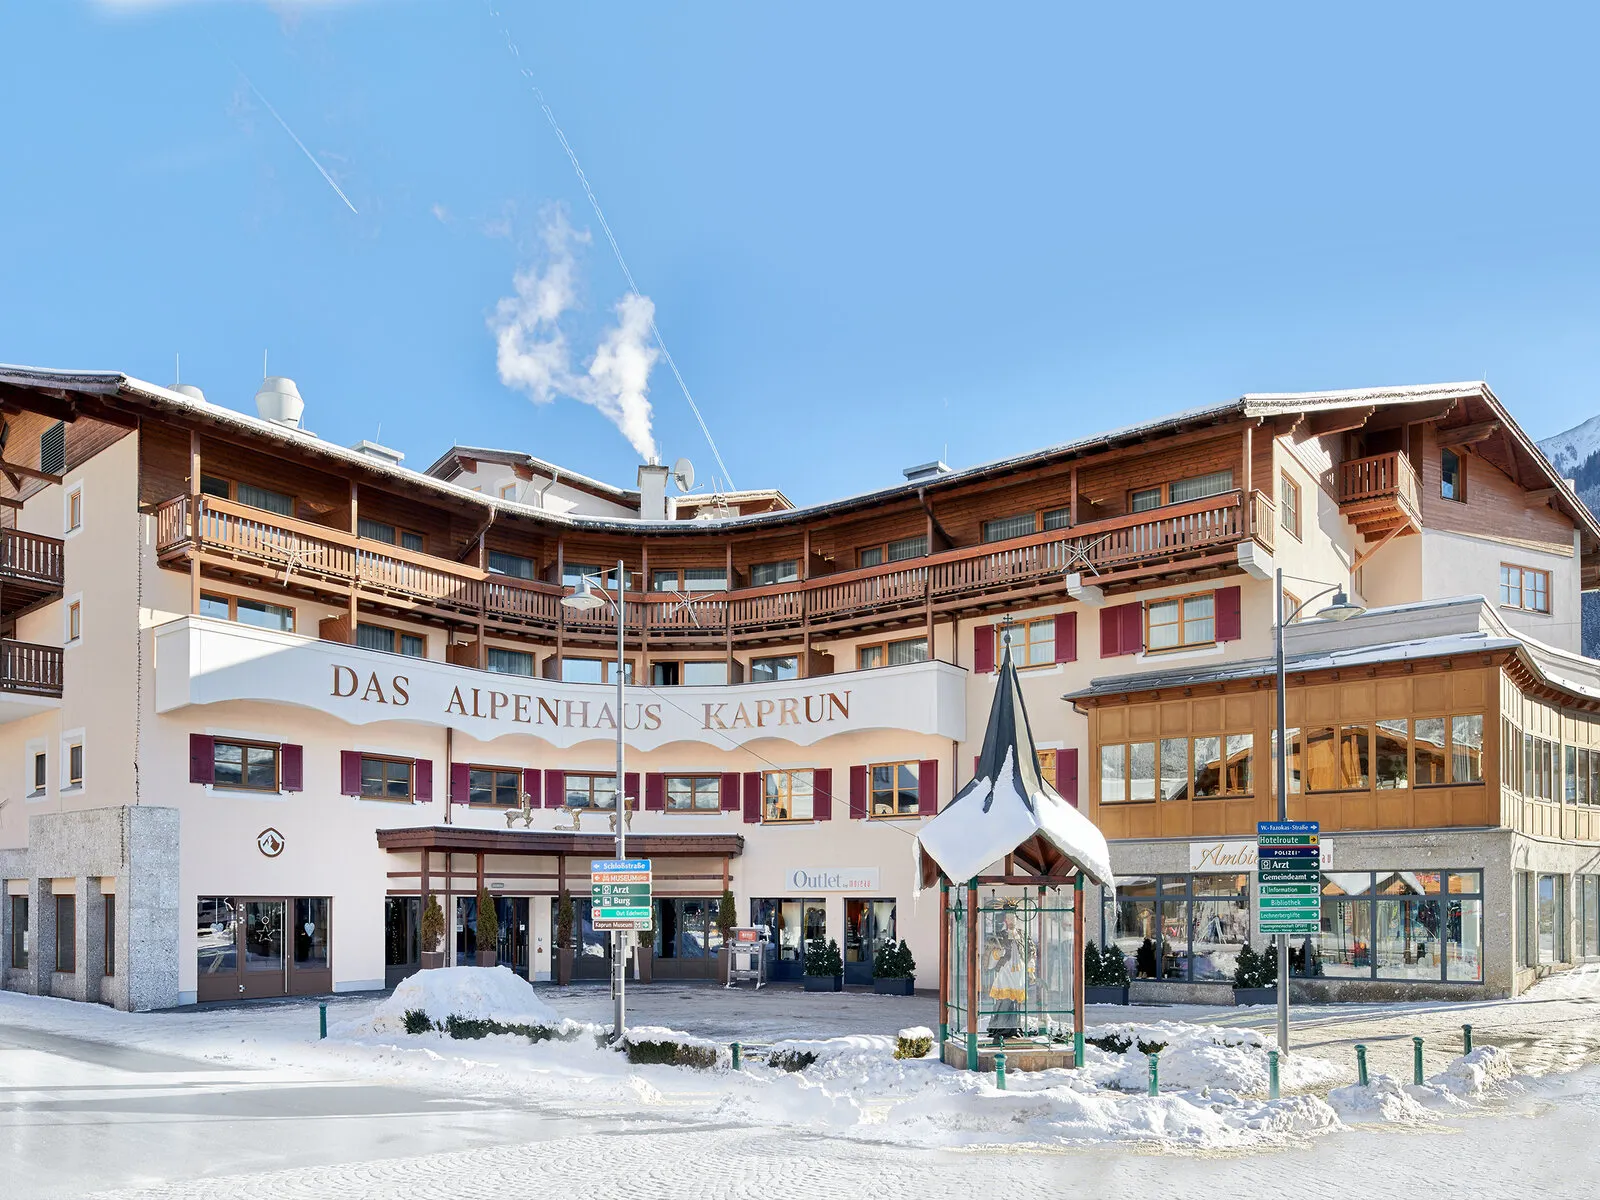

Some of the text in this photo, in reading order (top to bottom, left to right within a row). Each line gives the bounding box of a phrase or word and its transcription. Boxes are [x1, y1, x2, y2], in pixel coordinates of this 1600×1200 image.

[330, 664, 852, 731] DAS ALPENHAUS KAPRUN
[1260, 836, 1299, 844] Hotelroute
[603, 862, 646, 870] Schloßstraße
[1272, 860, 1290, 869] Arzt
[793, 870, 842, 888] Outlet
[612, 886, 629, 894] Arzt
[613, 897, 630, 906] Burg
